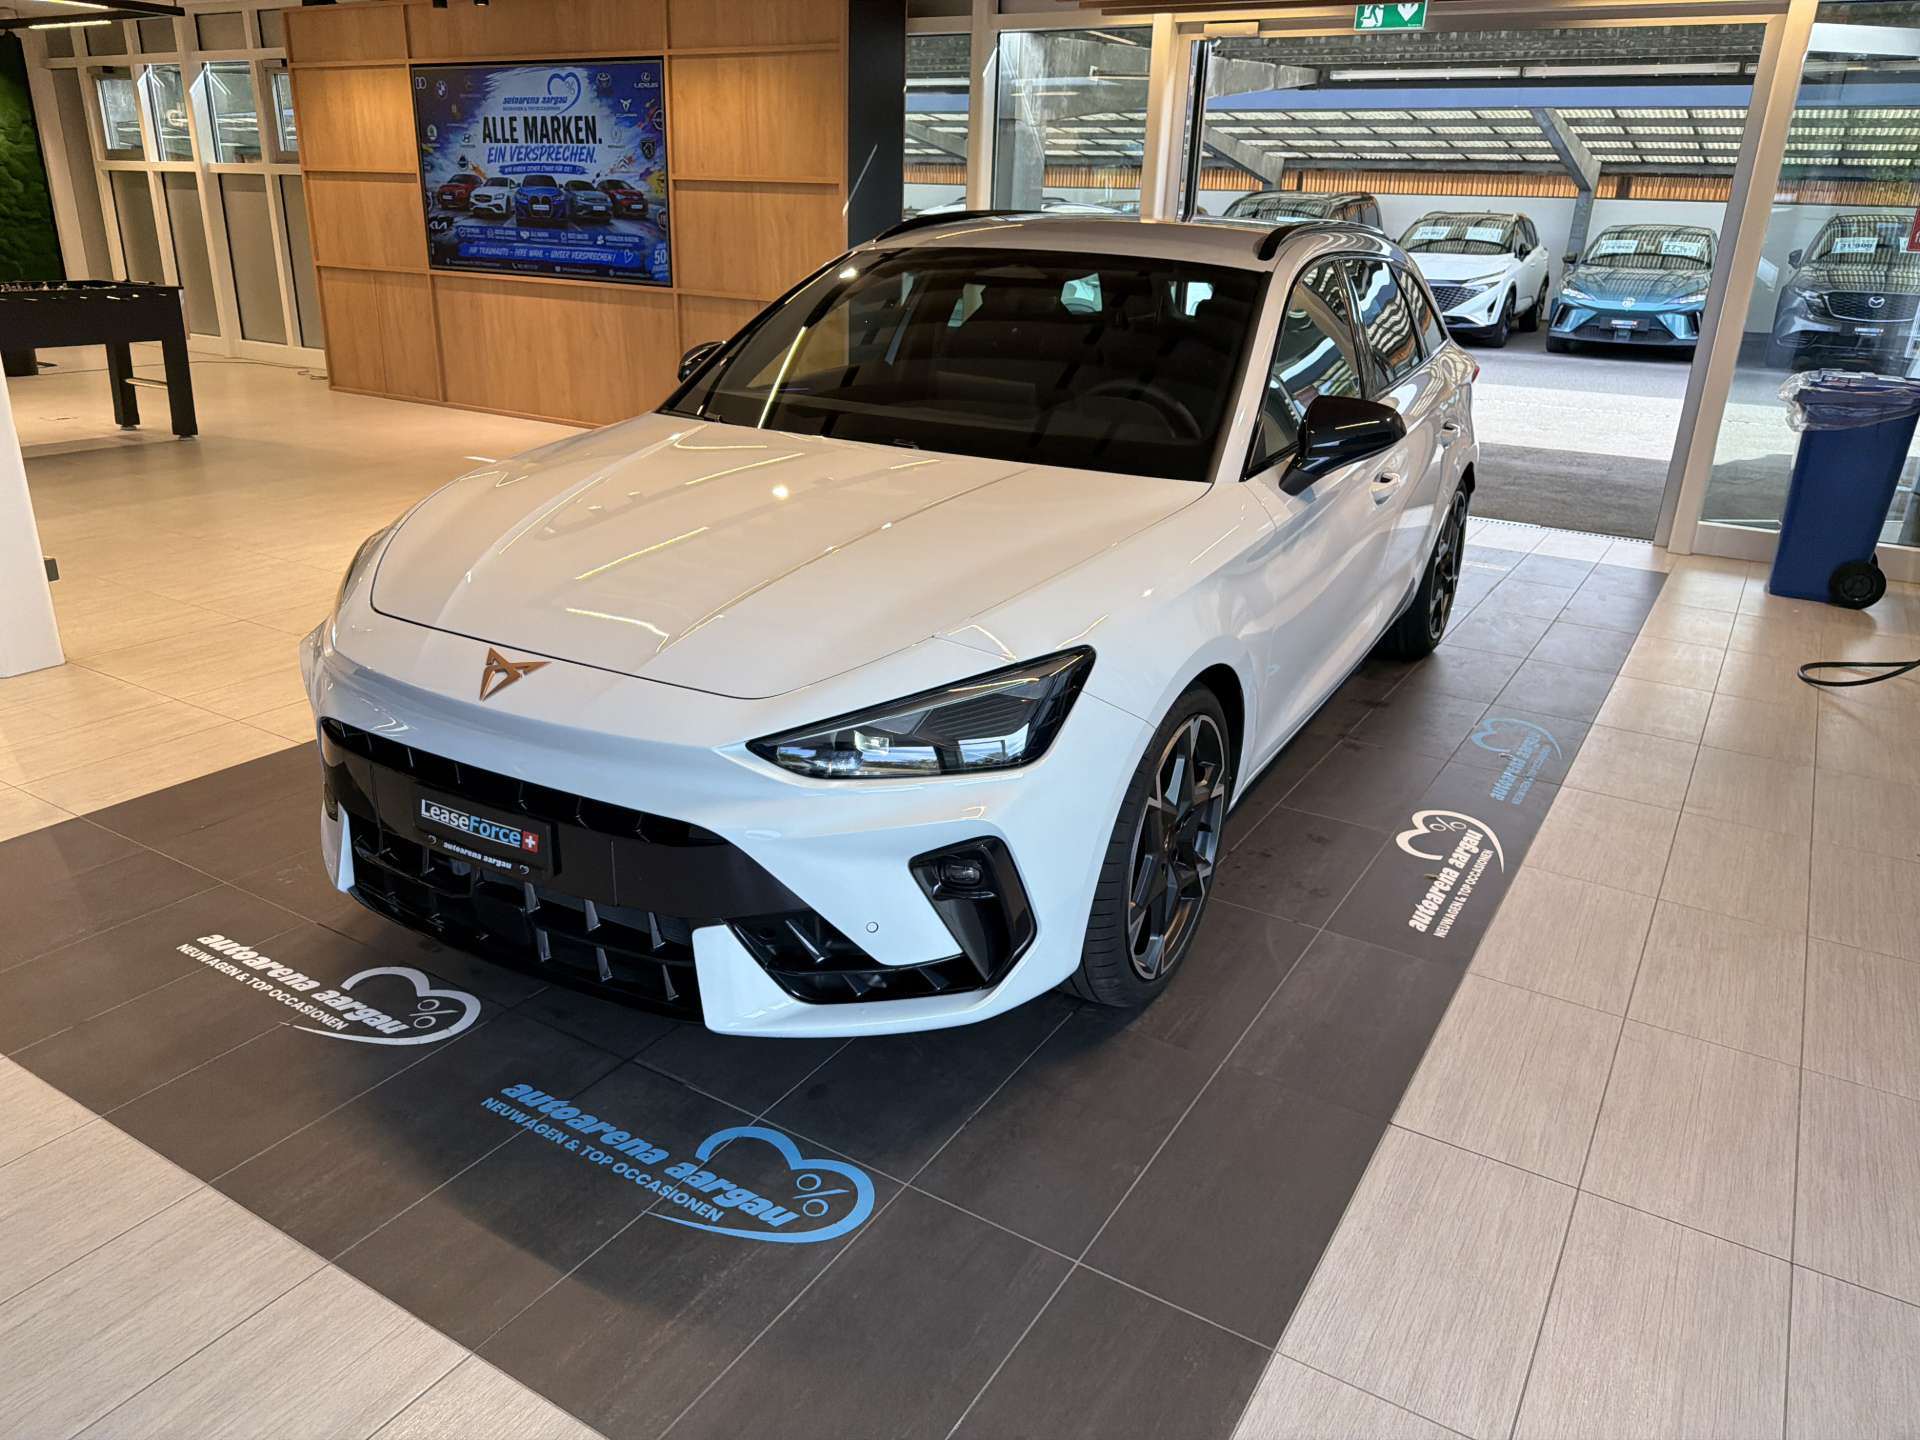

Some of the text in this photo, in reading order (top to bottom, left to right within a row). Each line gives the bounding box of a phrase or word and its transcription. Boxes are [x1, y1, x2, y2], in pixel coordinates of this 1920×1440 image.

[482, 115, 602, 144] ALLE MARKEN.
[487, 145, 597, 164] EIN VERSPRECHEN.
[421, 799, 521, 845] LeaseForce
[443, 841, 512, 869] autoarena aargau
[1408, 829, 1483, 933] autoarena aargau
[1433, 900, 1465, 938] NEUWAGEN
[1457, 883, 1473, 897] TOP
[176, 943, 243, 981] NEUWAGEN
[246, 976, 273, 993] TOP
[268, 988, 349, 1031] OCCASIONEN
[197, 934, 410, 1034] autoarena aargau
[481, 1097, 725, 1222] NEUWAGEN & TOP OCCASIONEN
[501, 1083, 799, 1227] autoarena aargau
